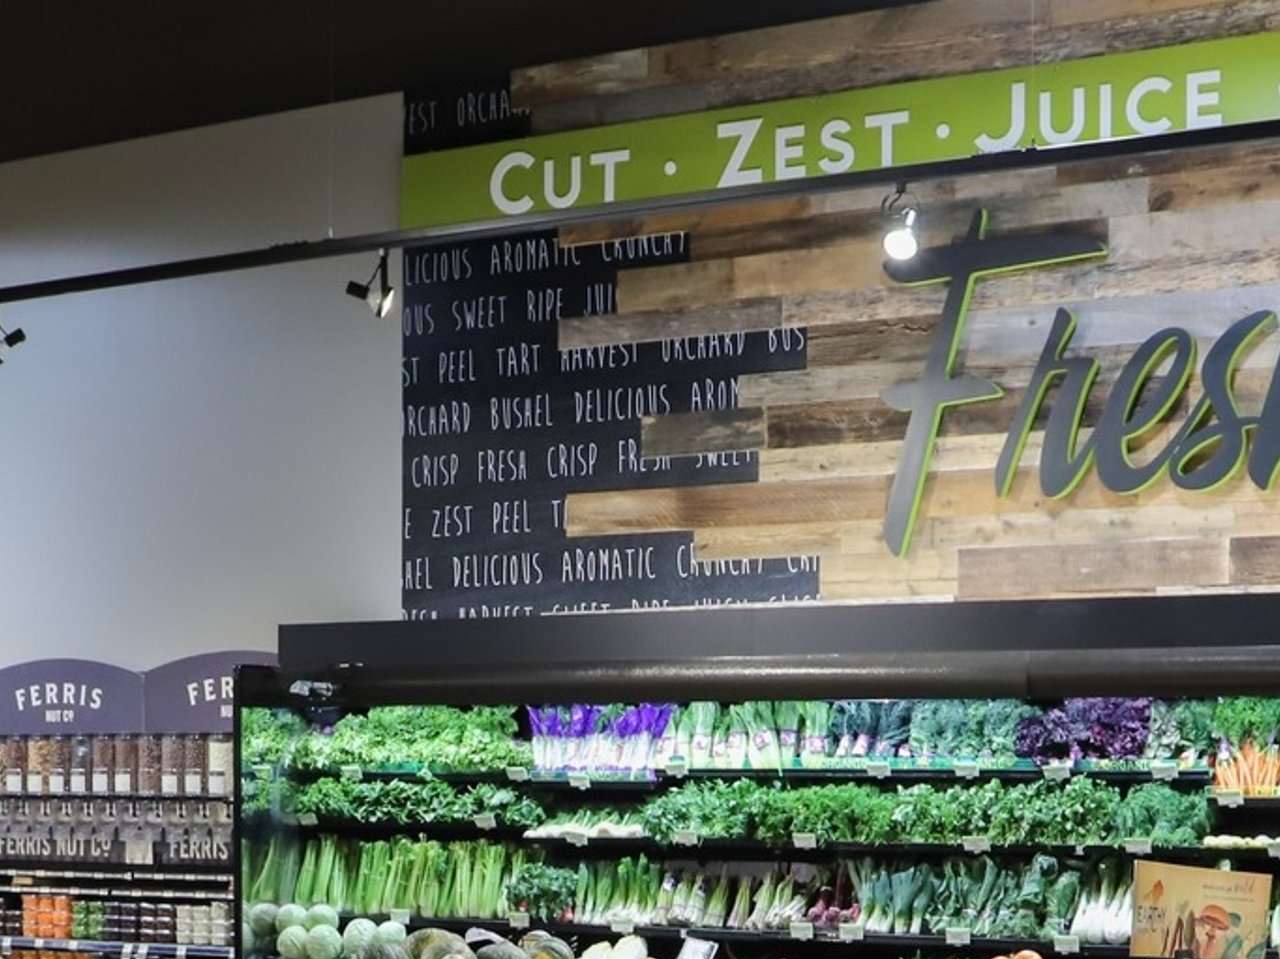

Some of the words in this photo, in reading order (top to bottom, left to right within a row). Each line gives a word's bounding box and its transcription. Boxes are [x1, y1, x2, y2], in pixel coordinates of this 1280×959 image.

[456, 89, 531, 127] ORCHA
[489, 149, 631, 216] CUT
[717, 113, 909, 188] ZEST
[975, 69, 1223, 154] JUICE
[490, 238, 581, 276] AROMATIC
[452, 295, 507, 331] SWEET
[527, 288, 563, 322] RIPE
[438, 348, 476, 384] PEEL
[496, 342, 541, 378] TART
[489, 392, 554, 431] BUSHEL
[574, 382, 671, 424] DELICIOUS
[411, 453, 460, 488] CRISP
[477, 449, 528, 484] FRESH
[547, 442, 599, 479] CRISP
[431, 505, 474, 538] ZEST
[492, 499, 532, 534] PEEL
[401, 556, 433, 590] HEL
[452, 552, 544, 588] DELICIOUS
[561, 546, 657, 583] AROMATIC
[15, 682, 103, 712] FERRIS
[169, 838, 229, 860] FERRIS
